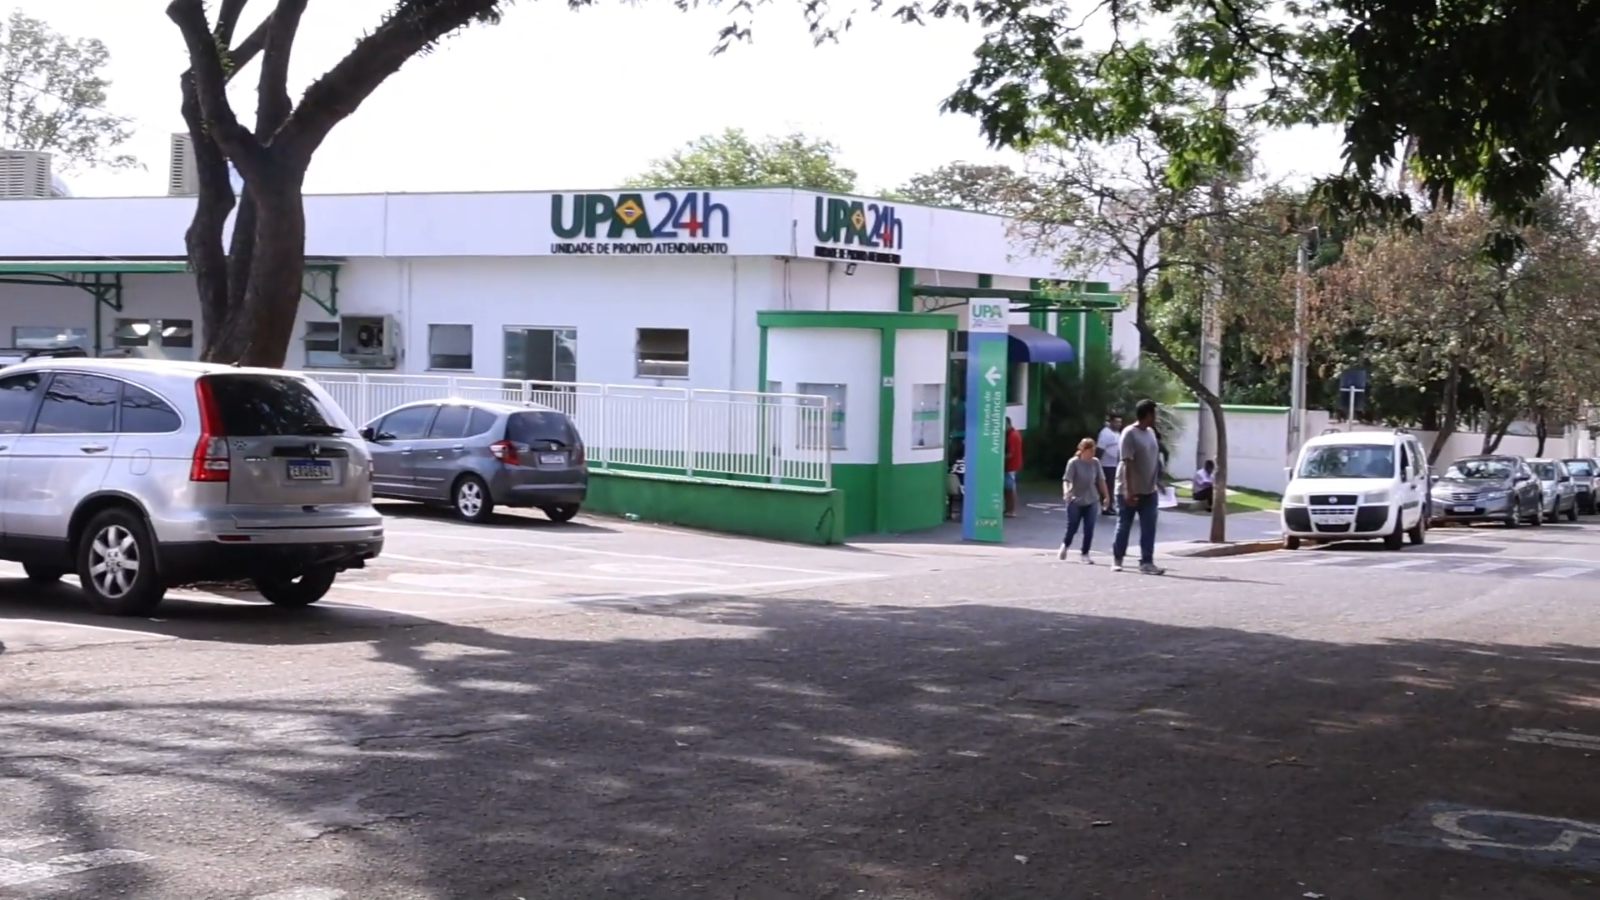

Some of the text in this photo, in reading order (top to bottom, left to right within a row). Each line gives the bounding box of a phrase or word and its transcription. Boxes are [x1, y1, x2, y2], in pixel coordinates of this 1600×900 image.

[551, 243, 728, 255] UNIDADE DE PRONTO ATENDIMENTO
[972, 304, 1004, 318] UPA
[983, 403, 991, 436] Entrada
[991, 391, 1001, 453] Ambulância
